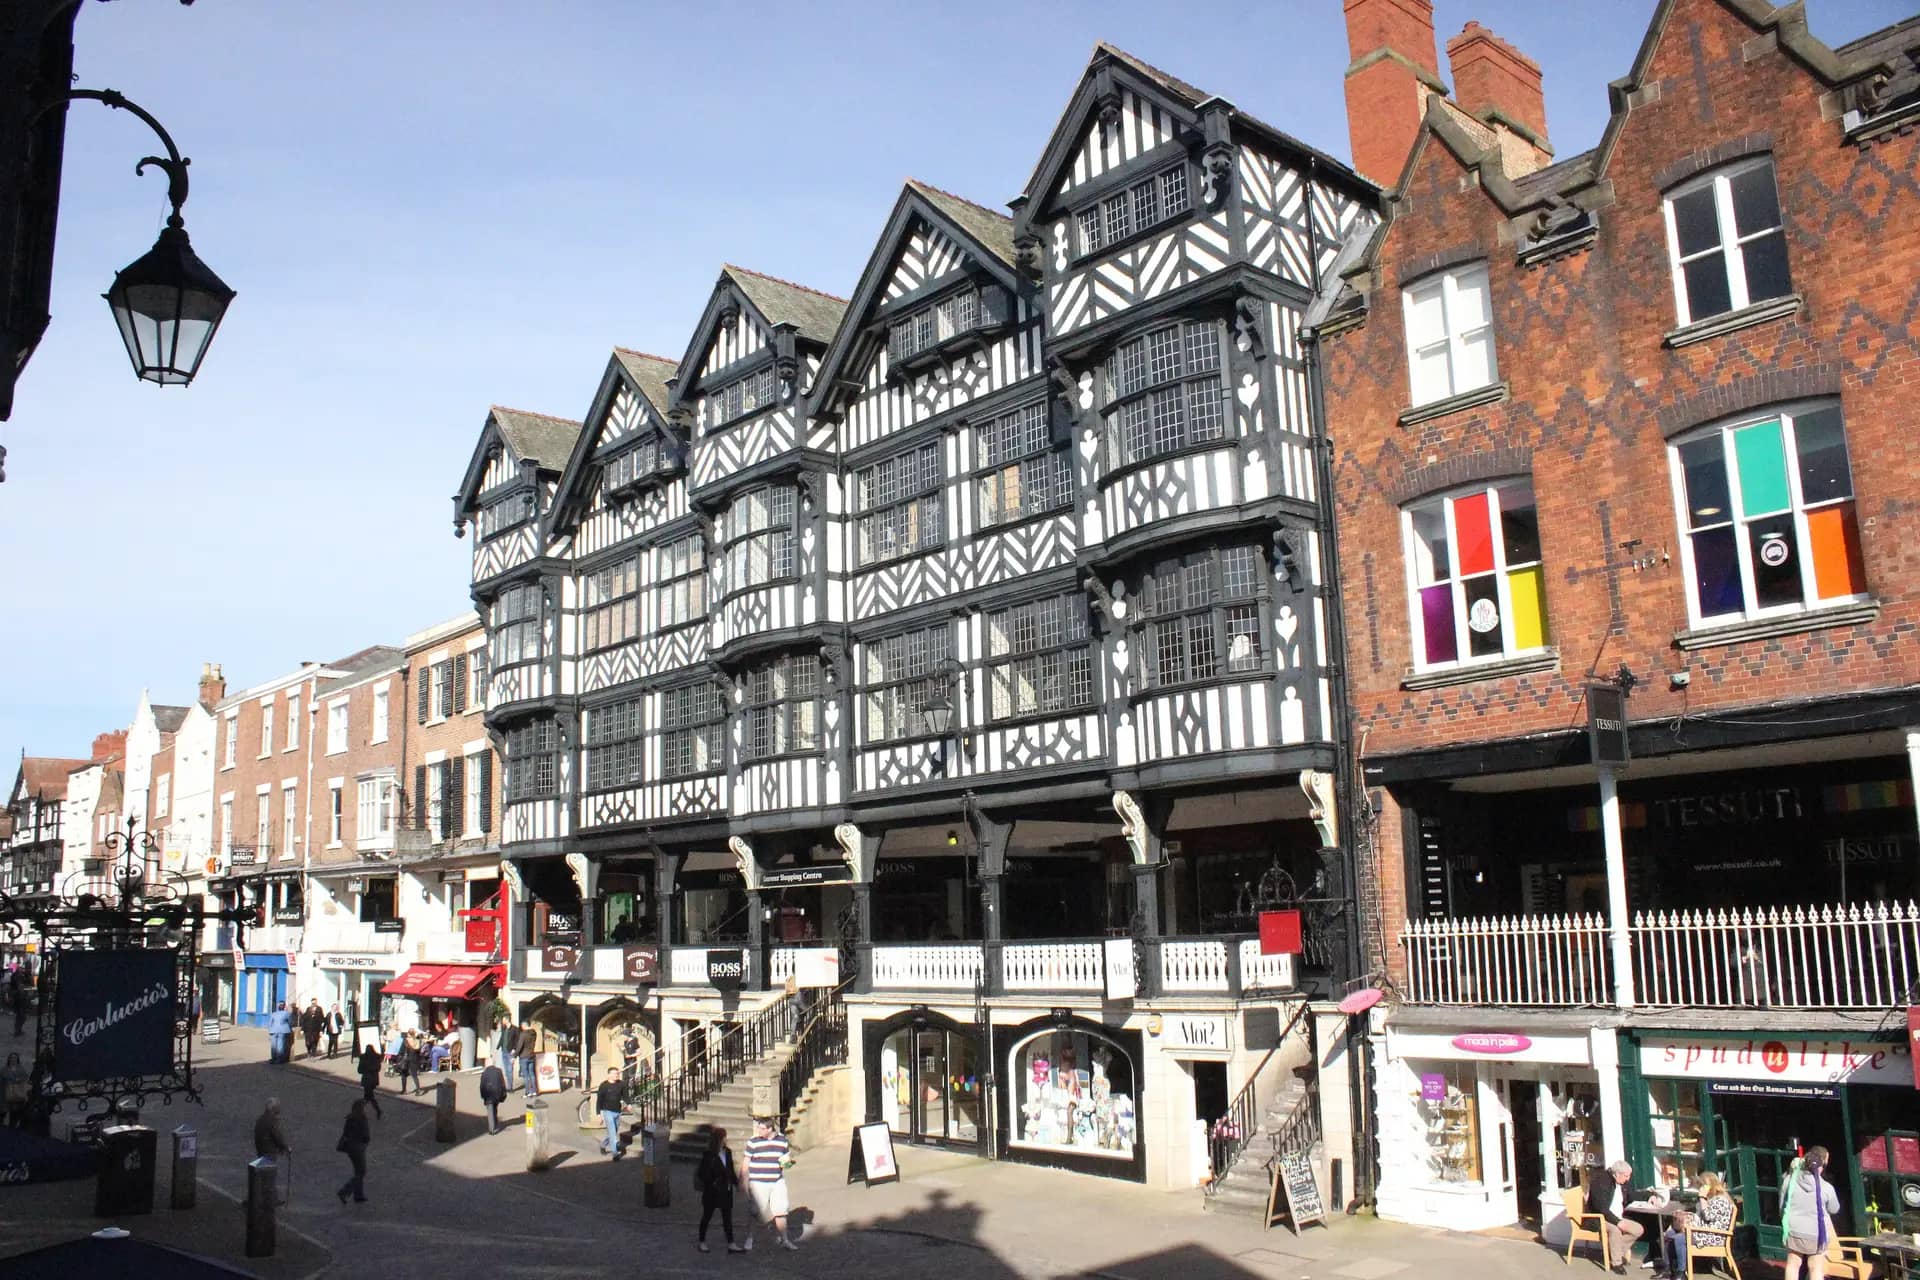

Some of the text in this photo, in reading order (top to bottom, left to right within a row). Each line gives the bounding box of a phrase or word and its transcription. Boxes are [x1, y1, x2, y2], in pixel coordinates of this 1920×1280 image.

[1595, 718, 1621, 731] TESSUTI
[1655, 788, 1802, 827] TESSUTI
[802, 871, 823, 880] Centre
[879, 862, 915, 873] BOSS
[710, 962, 741, 974] BOSS
[63, 981, 169, 1045] Carluccio's
[1179, 1020, 1216, 1046] Moi?
[1663, 1039, 1754, 1071] spud
[1799, 1039, 1888, 1071] like
